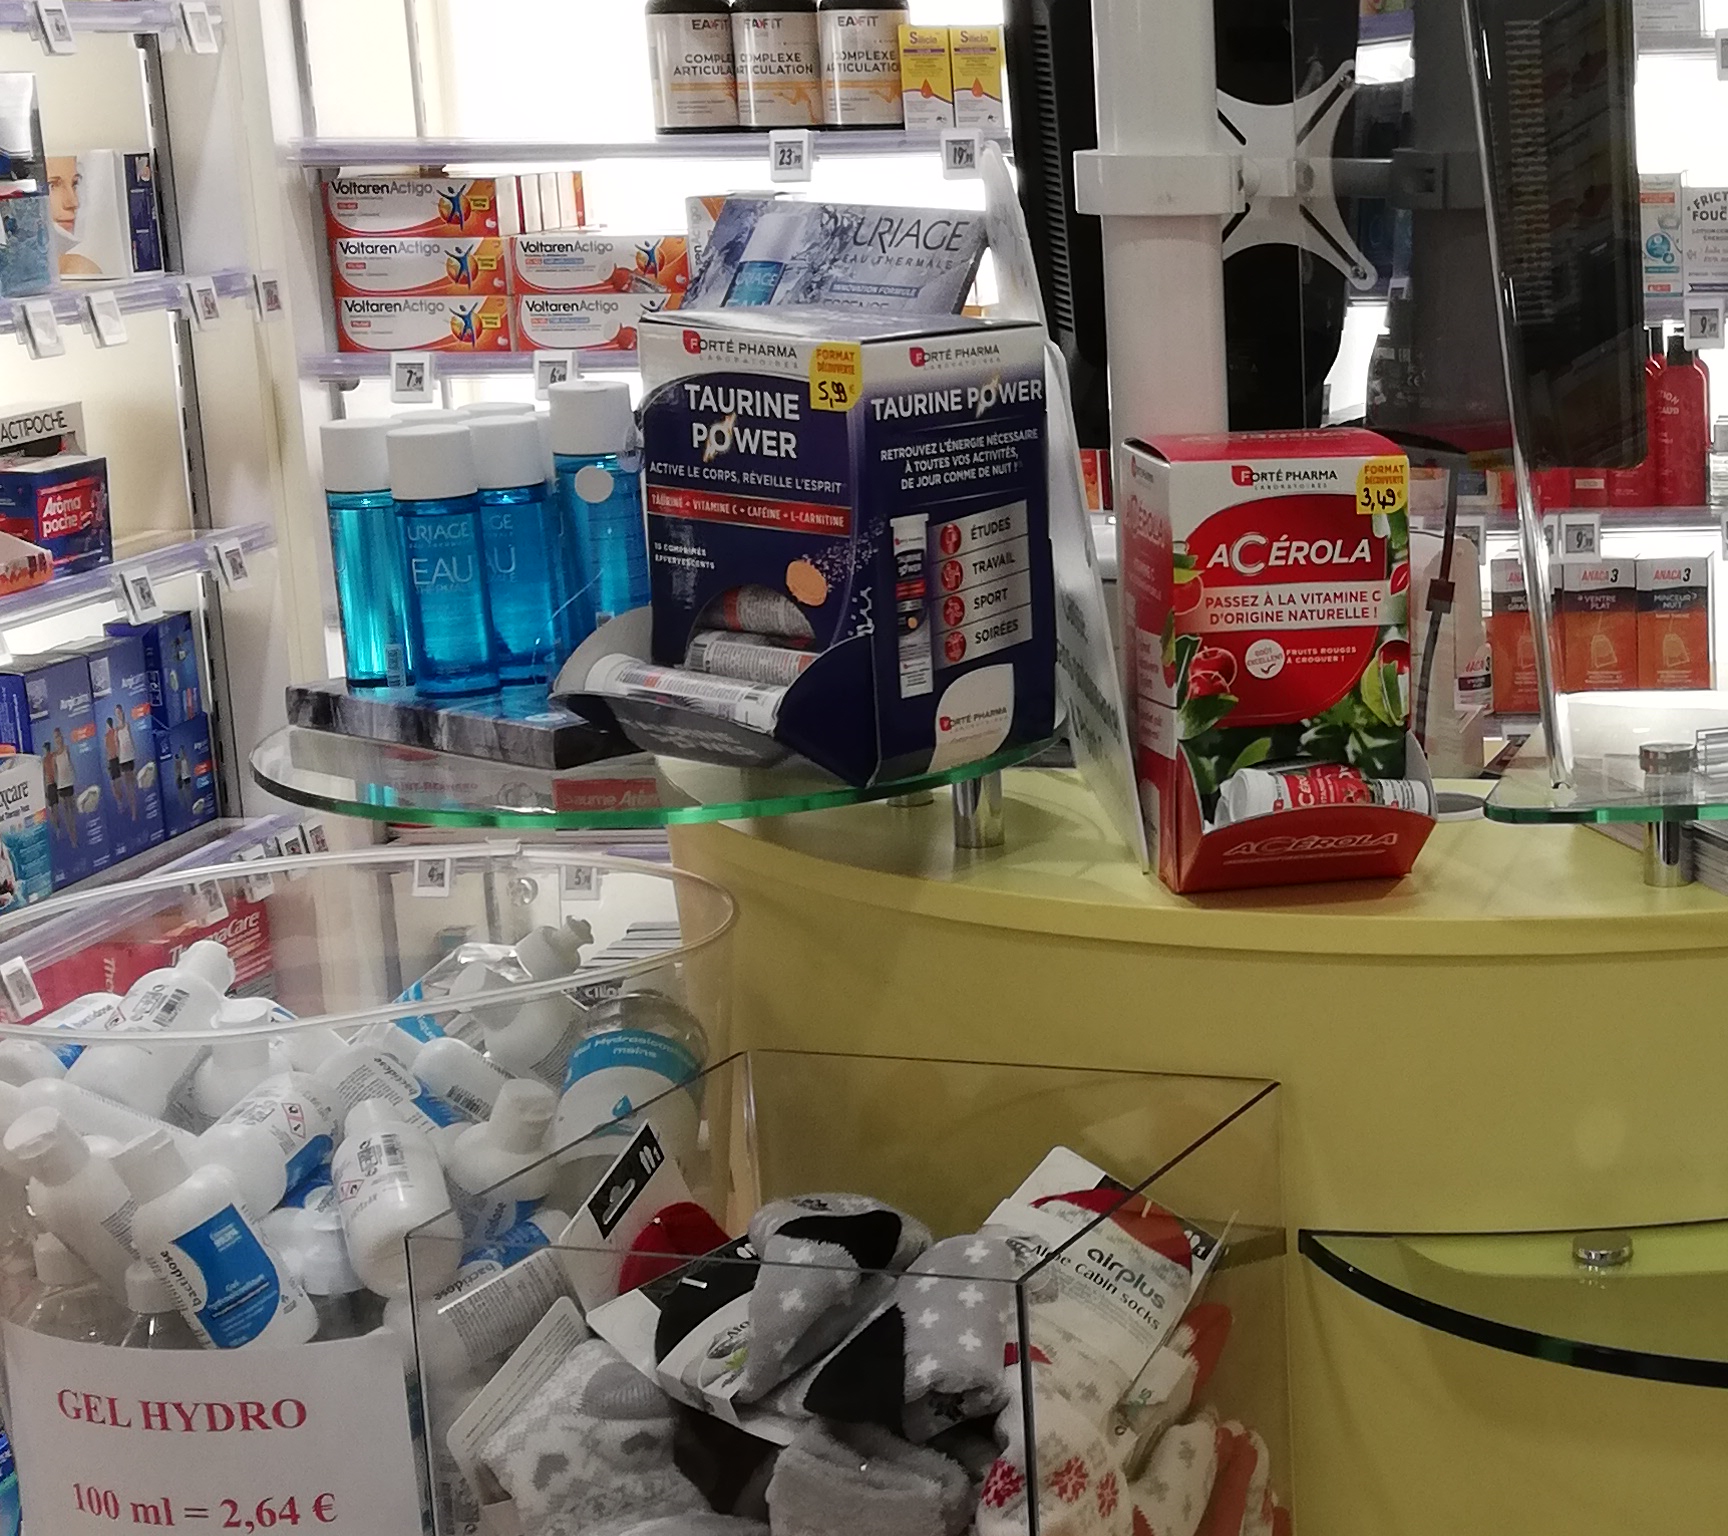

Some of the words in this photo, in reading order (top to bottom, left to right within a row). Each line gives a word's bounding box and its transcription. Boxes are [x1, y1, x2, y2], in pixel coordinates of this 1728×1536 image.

[738, 342, 797, 359] PHARMA
[684, 383, 800, 420] TAURINE
[871, 388, 963, 421] TAURINE
[967, 378, 1043, 414] POWER
[692, 421, 797, 460] POWER
[649, 461, 685, 479] ACTIVE
[688, 466, 700, 478] LE
[702, 467, 741, 485] CORPS,
[743, 470, 793, 489] RÉVEILLE
[795, 477, 841, 494] L'ESPRIT
[1286, 470, 1338, 481] PHARMA
[971, 517, 1011, 541] ÉTUDES
[972, 552, 1015, 575] TRAVAIL
[1206, 531, 1371, 576] ACÉROLA
[973, 588, 1008, 610] SPORT
[1205, 594, 1258, 609] PASSEZ
[1264, 591, 1273, 605] À
[1278, 594, 1296, 605] LA
[1302, 591, 1367, 605] VITAMINE
[1372, 590, 1381, 602] C
[1210, 611, 1283, 625] D'ORIGINE
[1288, 608, 1369, 622] NATURELLE
[974, 620, 1019, 645] SOIRÉES
[1122, 1292, 1160, 1331] socks
[58, 1389, 132, 1428] GEL
[139, 1398, 307, 1432] HYDRO
[73, 1483, 119, 1520] 100
[130, 1497, 175, 1526] ml
[221, 1495, 300, 1534] 2,64
[312, 1492, 338, 1523] €
